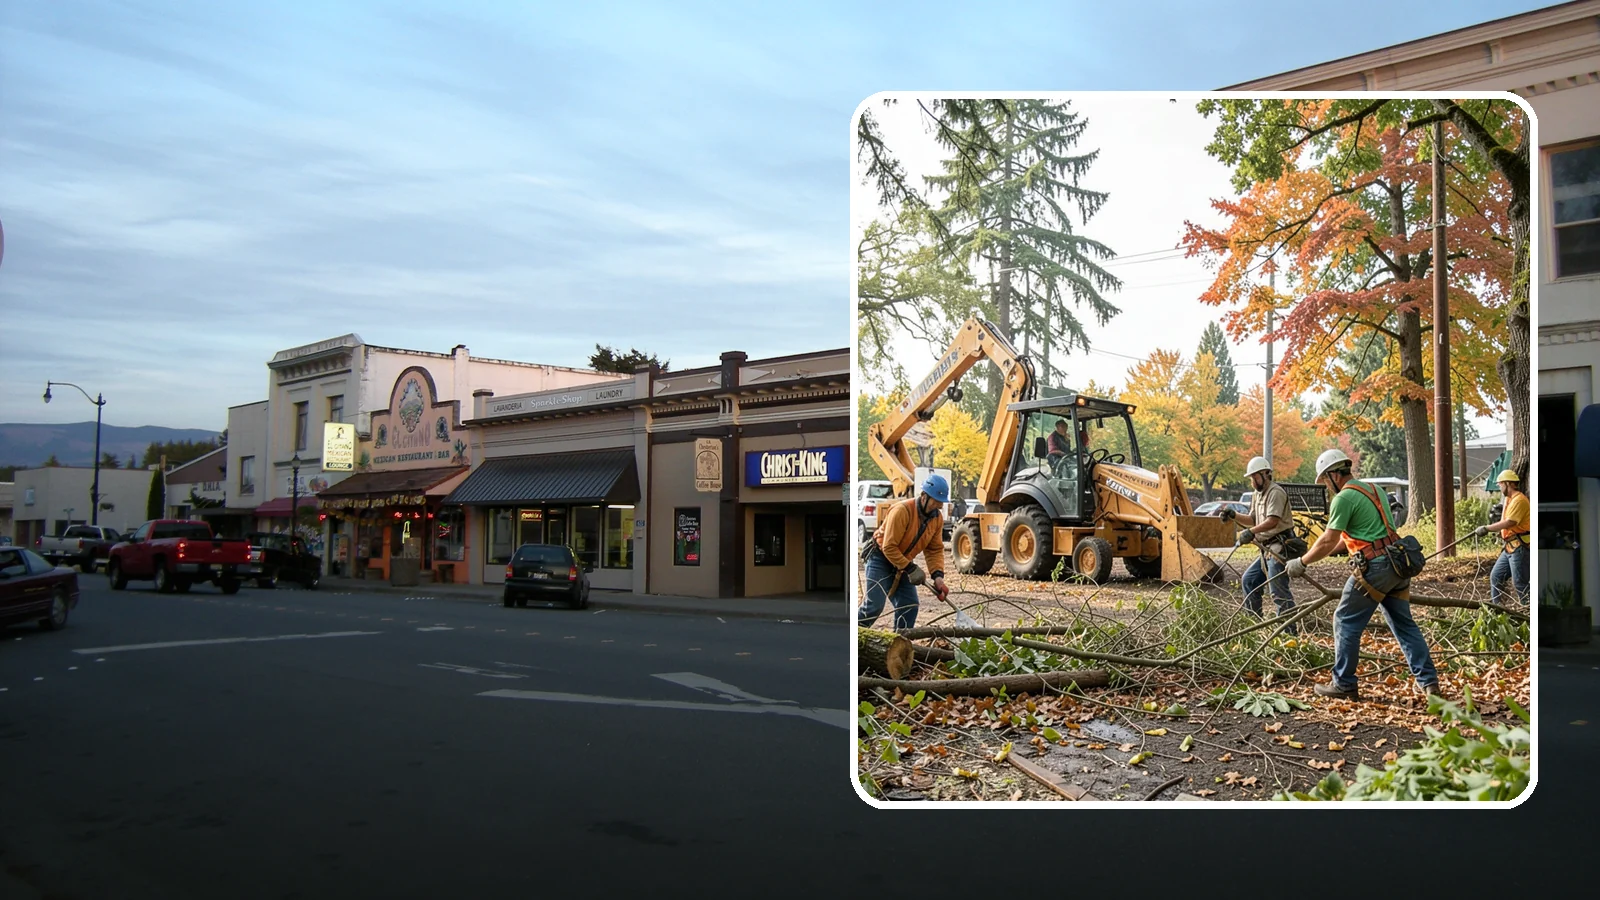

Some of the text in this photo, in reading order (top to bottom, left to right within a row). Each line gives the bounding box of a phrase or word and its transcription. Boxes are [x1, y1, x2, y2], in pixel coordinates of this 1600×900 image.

[530, 394, 582, 409] Sparkle Shop
[595, 389, 624, 400] LAUNDRY
[493, 402, 523, 413] LAVANDERIA
[373, 450, 450, 464] MEXICAN RESTAURANT BAR
[761, 450, 827, 478] CHRIST KING
